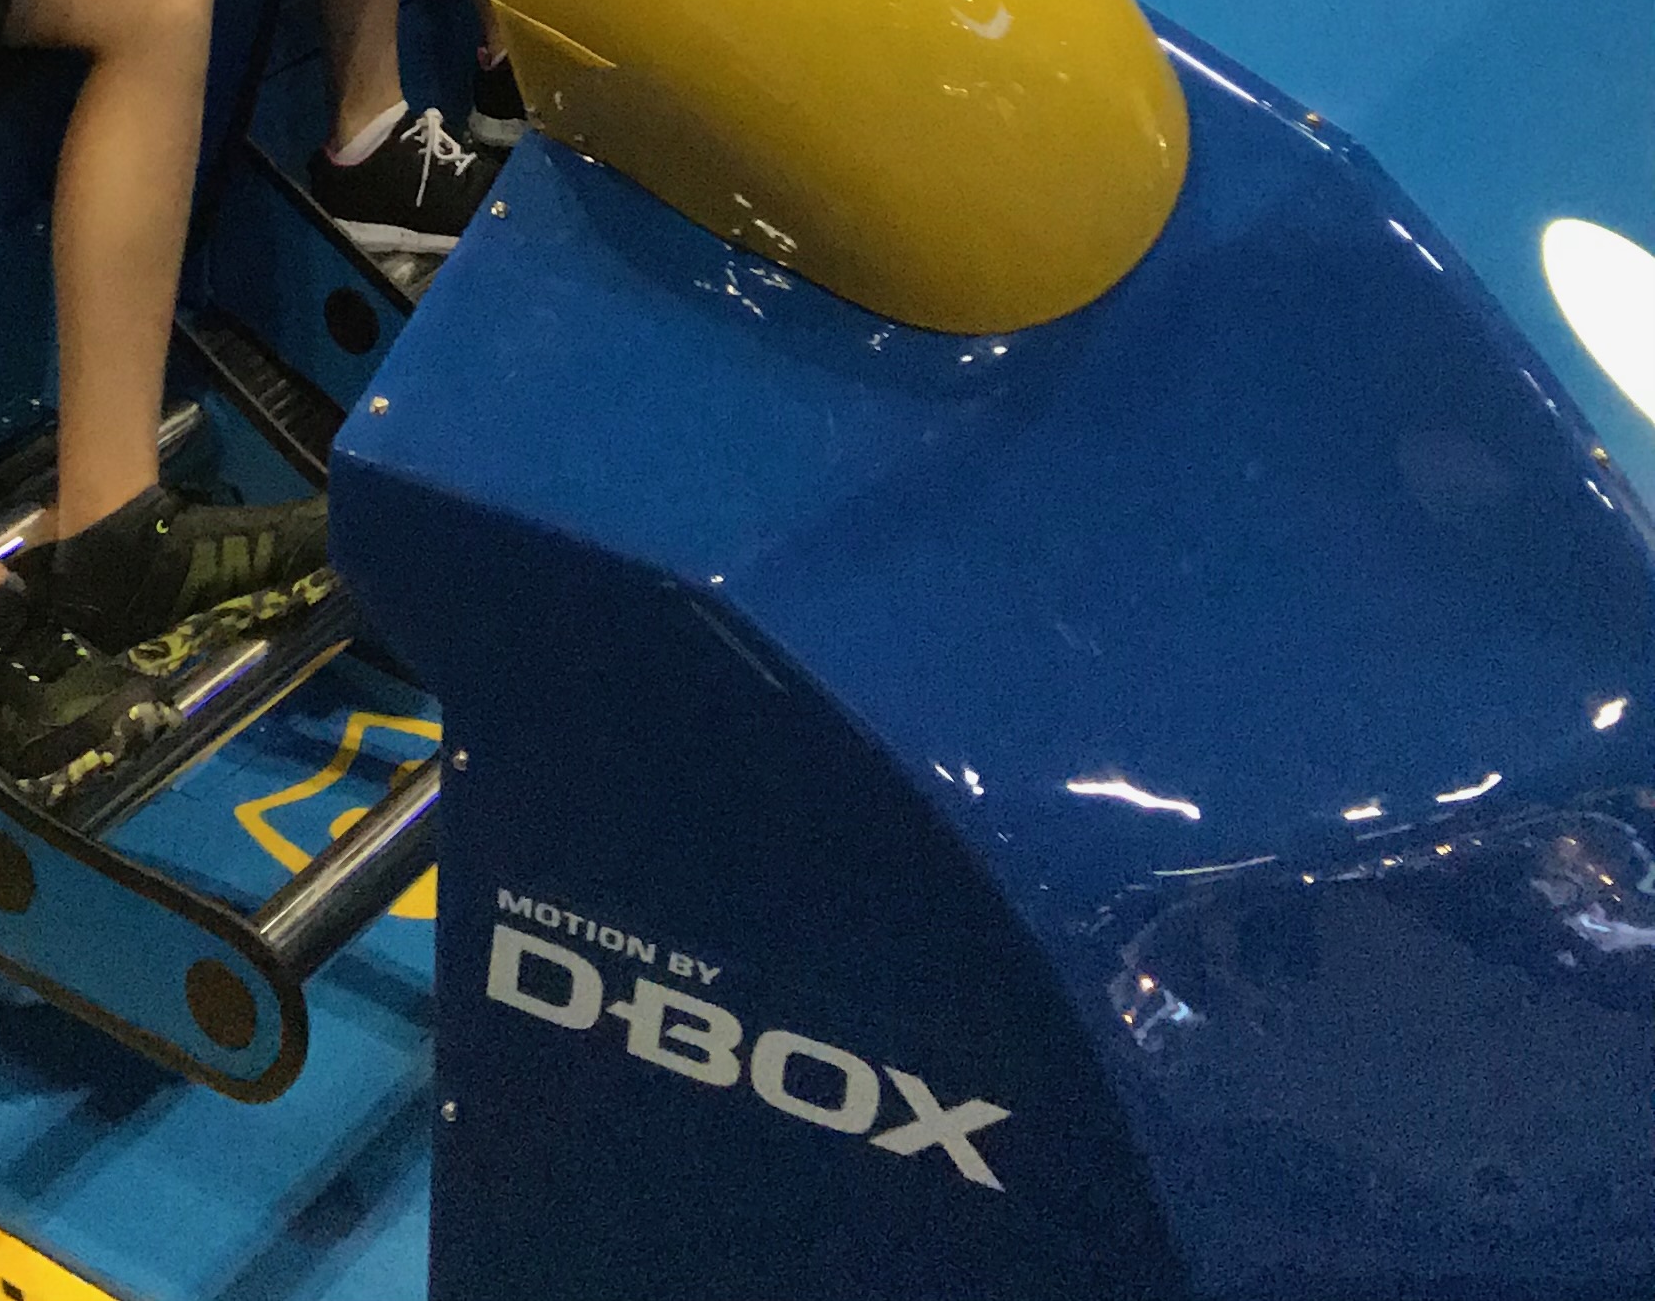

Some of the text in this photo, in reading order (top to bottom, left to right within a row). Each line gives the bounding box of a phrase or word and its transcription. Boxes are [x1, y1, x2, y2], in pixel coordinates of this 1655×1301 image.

[497, 888, 722, 986] MOTION BY
[486, 924, 1012, 1192] D-BOX
